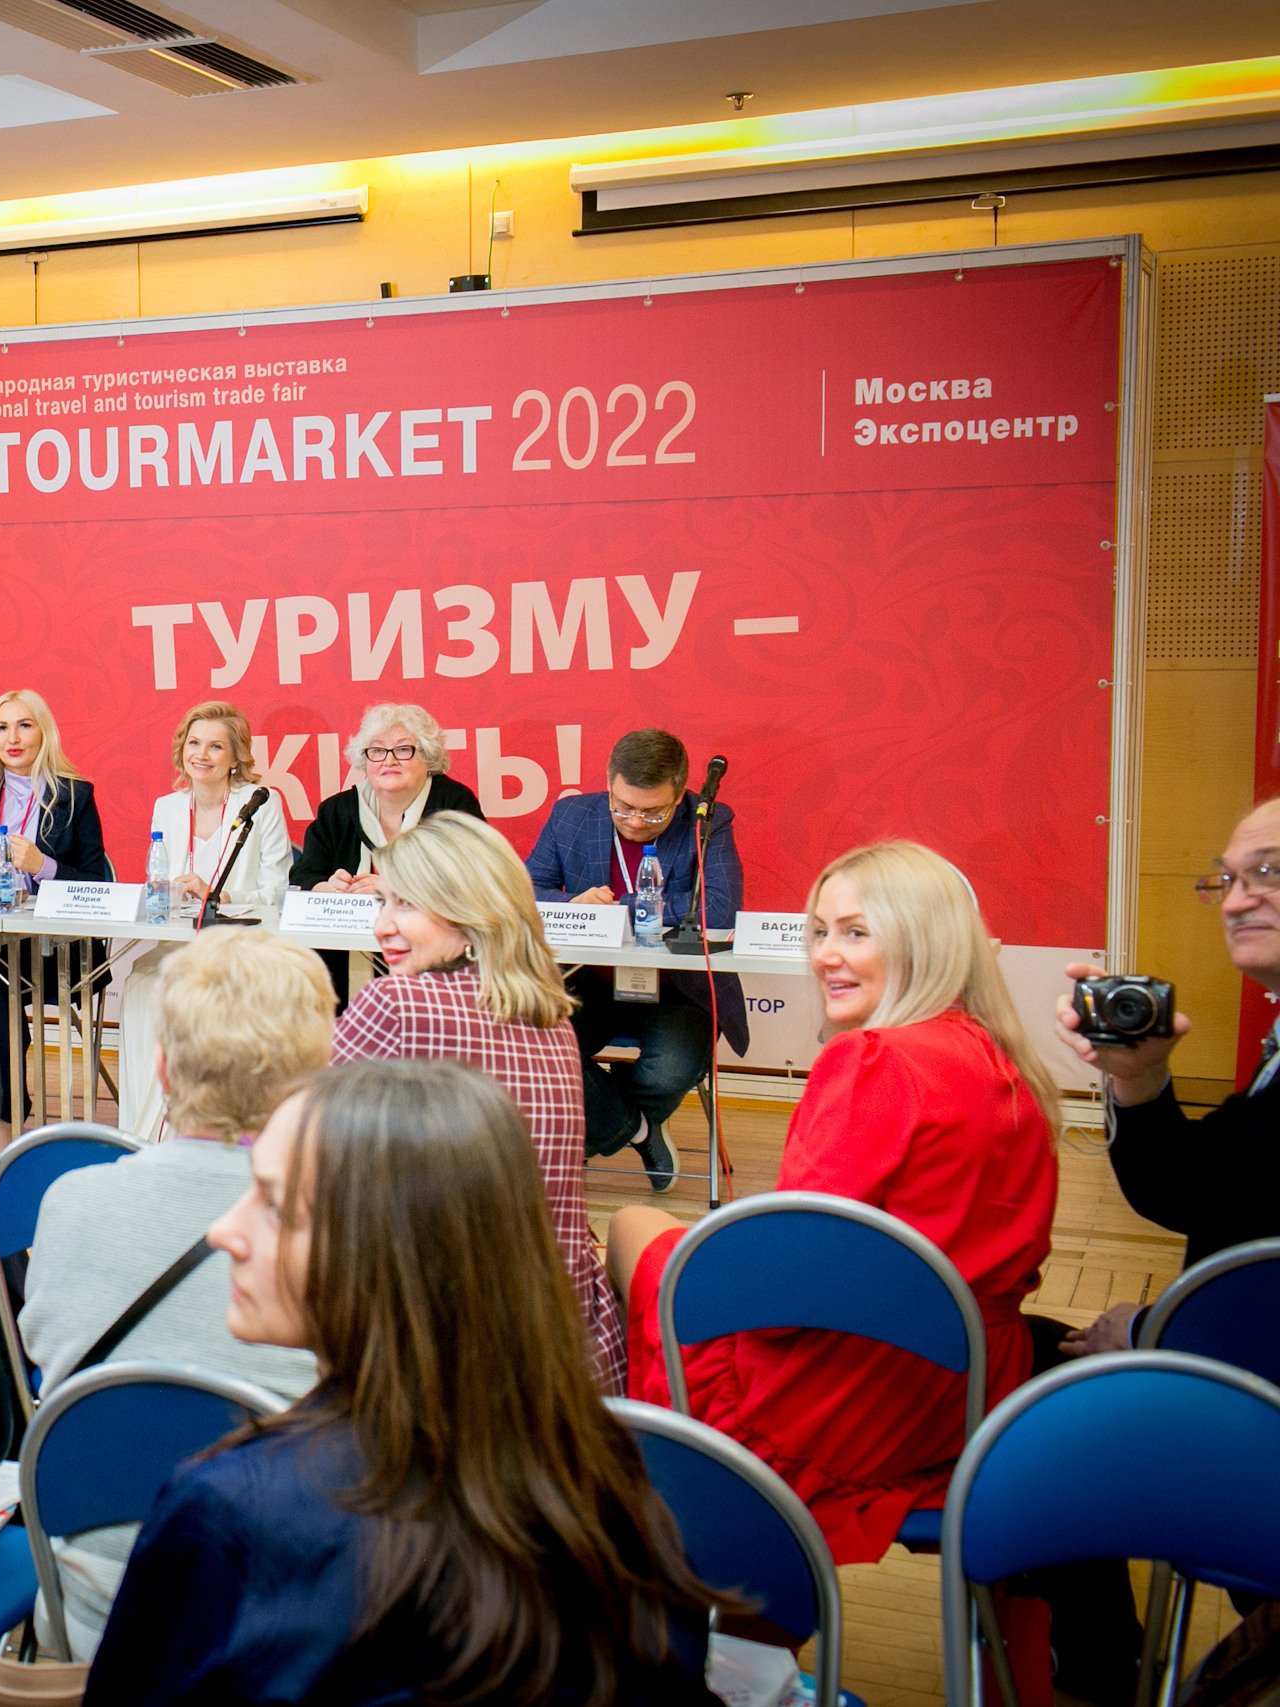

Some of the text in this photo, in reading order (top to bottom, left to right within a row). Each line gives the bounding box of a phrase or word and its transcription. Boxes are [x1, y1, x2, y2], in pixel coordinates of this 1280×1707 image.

[82, 364, 237, 392] туристическая
[244, 357, 347, 378] выставка
[854, 377, 993, 405] Москва
[35, 394, 87, 416] travel
[94, 392, 127, 413] and
[134, 389, 206, 410] tourism
[213, 384, 265, 406] trade
[272, 381, 307, 402] fair
[511, 380, 696, 471] 2022
[853, 414, 1079, 446] Экспоцентр
[131, 570, 702, 691] ТУРИЗМУ
[67, 886, 111, 895] ШИЛОВА
[72, 895, 101, 903] Мария
[307, 897, 374, 907] ГОНЧАРОВА
[322, 907, 355, 916] Ирина
[539, 911, 597, 921] ОРШУНОВ
[545, 922, 587, 930] лексей
[761, 922, 807, 932] ВАСИЛ
